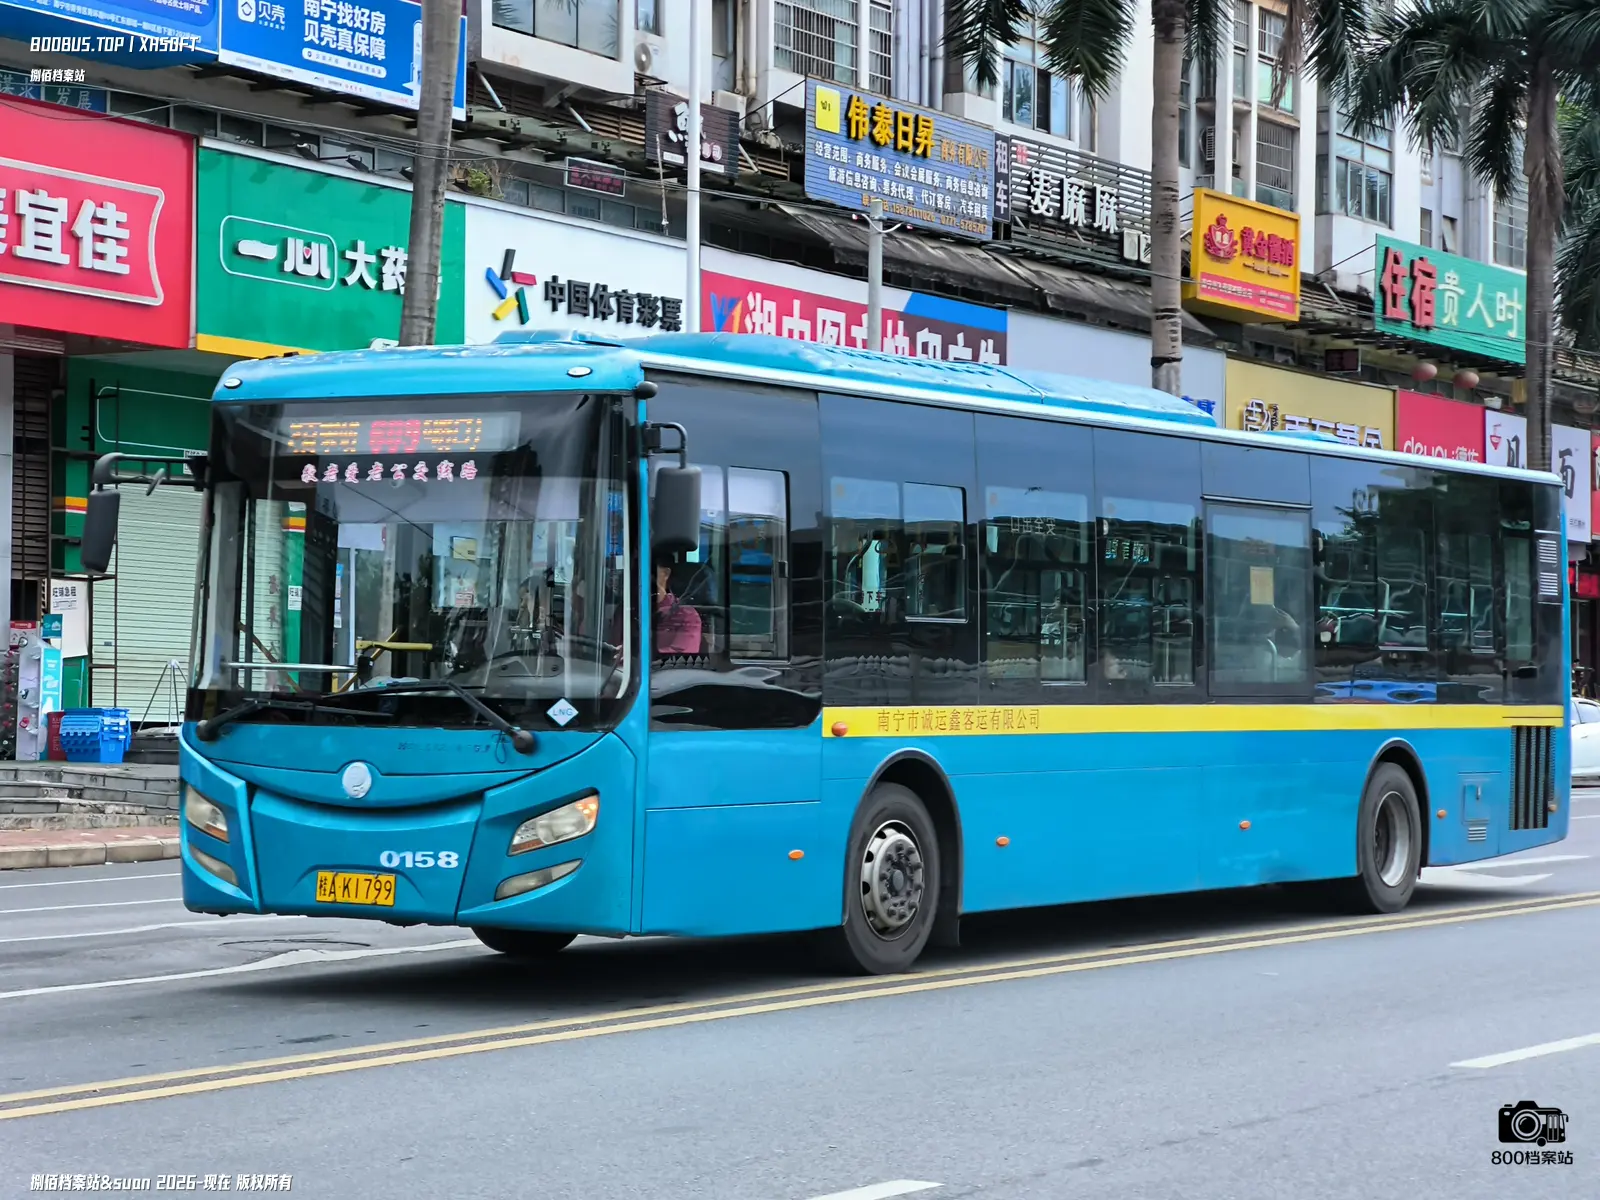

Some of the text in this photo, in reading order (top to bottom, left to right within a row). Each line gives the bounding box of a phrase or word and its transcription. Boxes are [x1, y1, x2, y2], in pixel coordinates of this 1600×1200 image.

[258, 0, 286, 25] 贝壳
[303, 0, 386, 35] 南宁找好房
[303, 19, 386, 61] 贝壳真保障
[995, 140, 1008, 214] 租车
[0, 188, 130, 276] 宜佳
[543, 275, 684, 332] 中国体育彩票
[1380, 247, 1523, 339] 住宿 贵人时
[553, 707, 574, 717] LNG
[877, 708, 1040, 732] 南宁市诚运鑫客运有限公司
[380, 851, 459, 868] 0158
